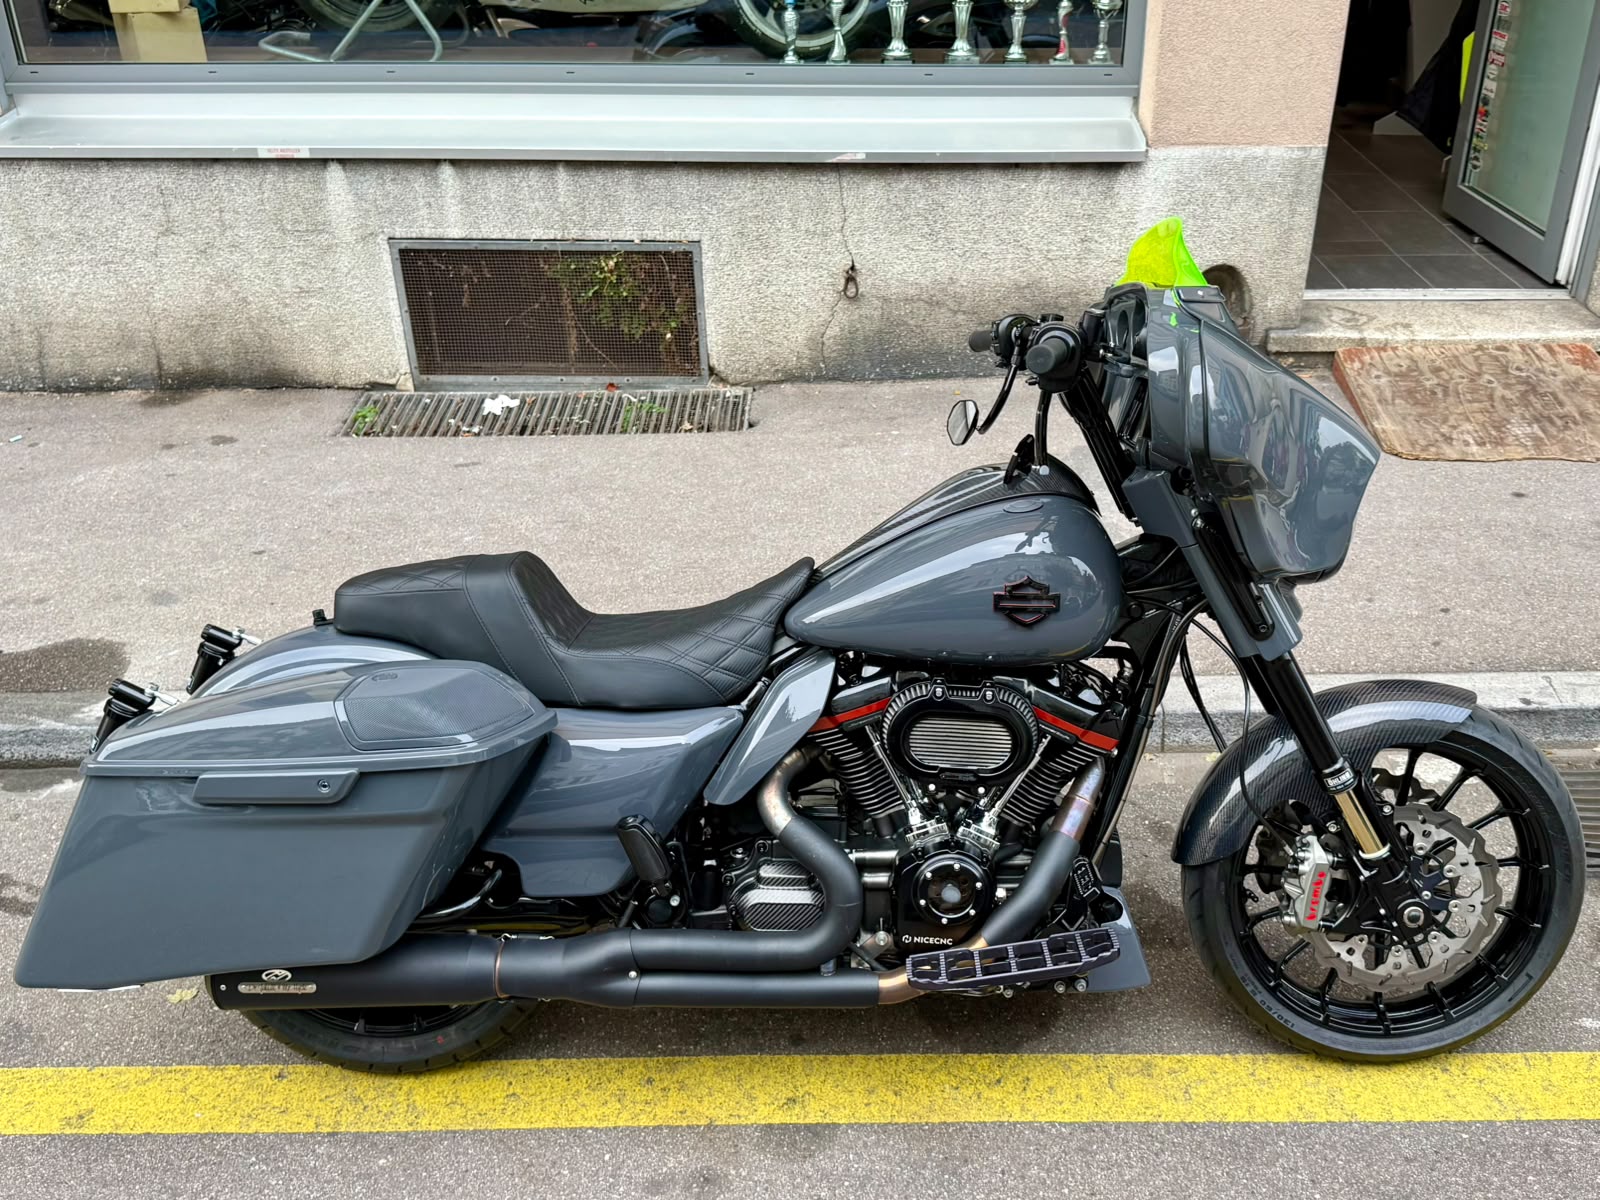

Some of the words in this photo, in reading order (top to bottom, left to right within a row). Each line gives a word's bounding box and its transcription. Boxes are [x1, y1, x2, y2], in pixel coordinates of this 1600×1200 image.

[1306, 871, 1327, 921] brembo
[913, 936, 953, 945] NICECNC
[1260, 1000, 1295, 1028] 130/60
